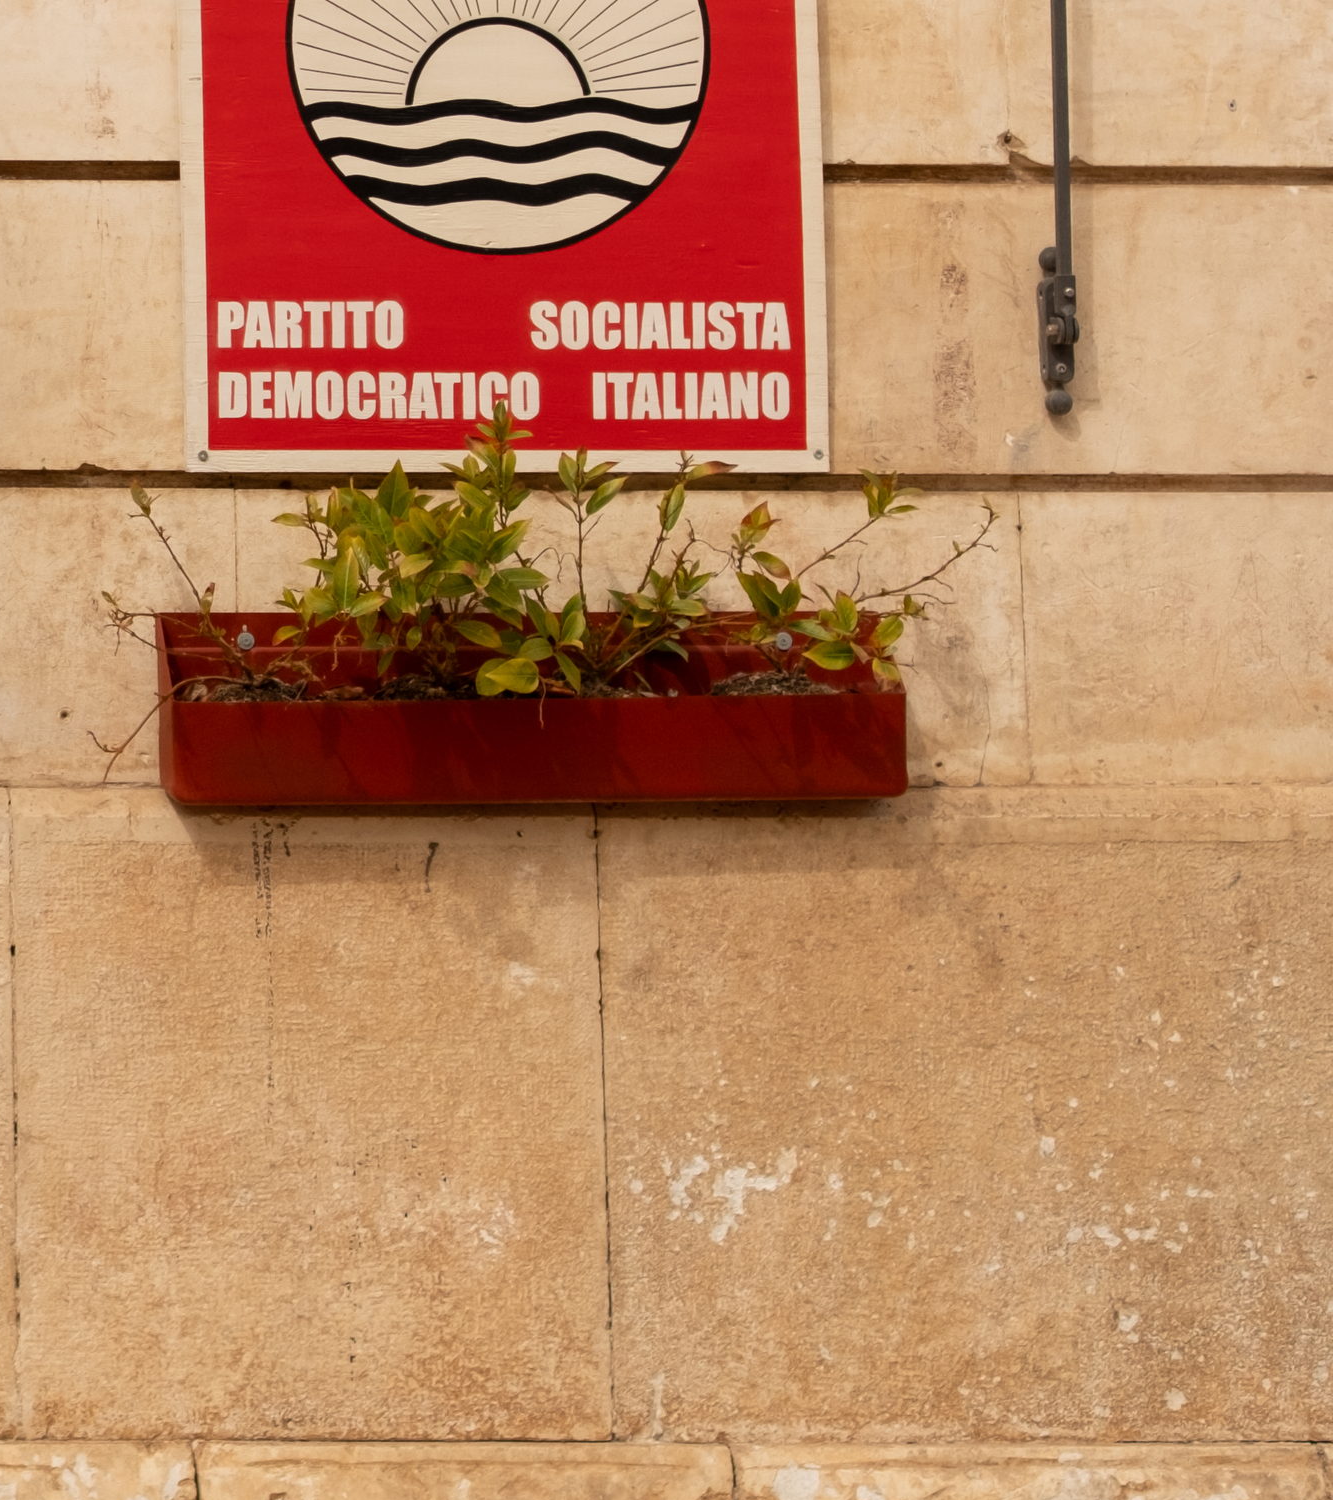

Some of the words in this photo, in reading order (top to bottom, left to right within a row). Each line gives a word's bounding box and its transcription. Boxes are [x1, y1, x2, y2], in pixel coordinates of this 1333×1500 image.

[217, 300, 404, 350] PARTITO
[529, 300, 791, 351] SOCIALISTA
[217, 370, 540, 421] DEMOCRATICO
[592, 371, 790, 421] ITALIANO
